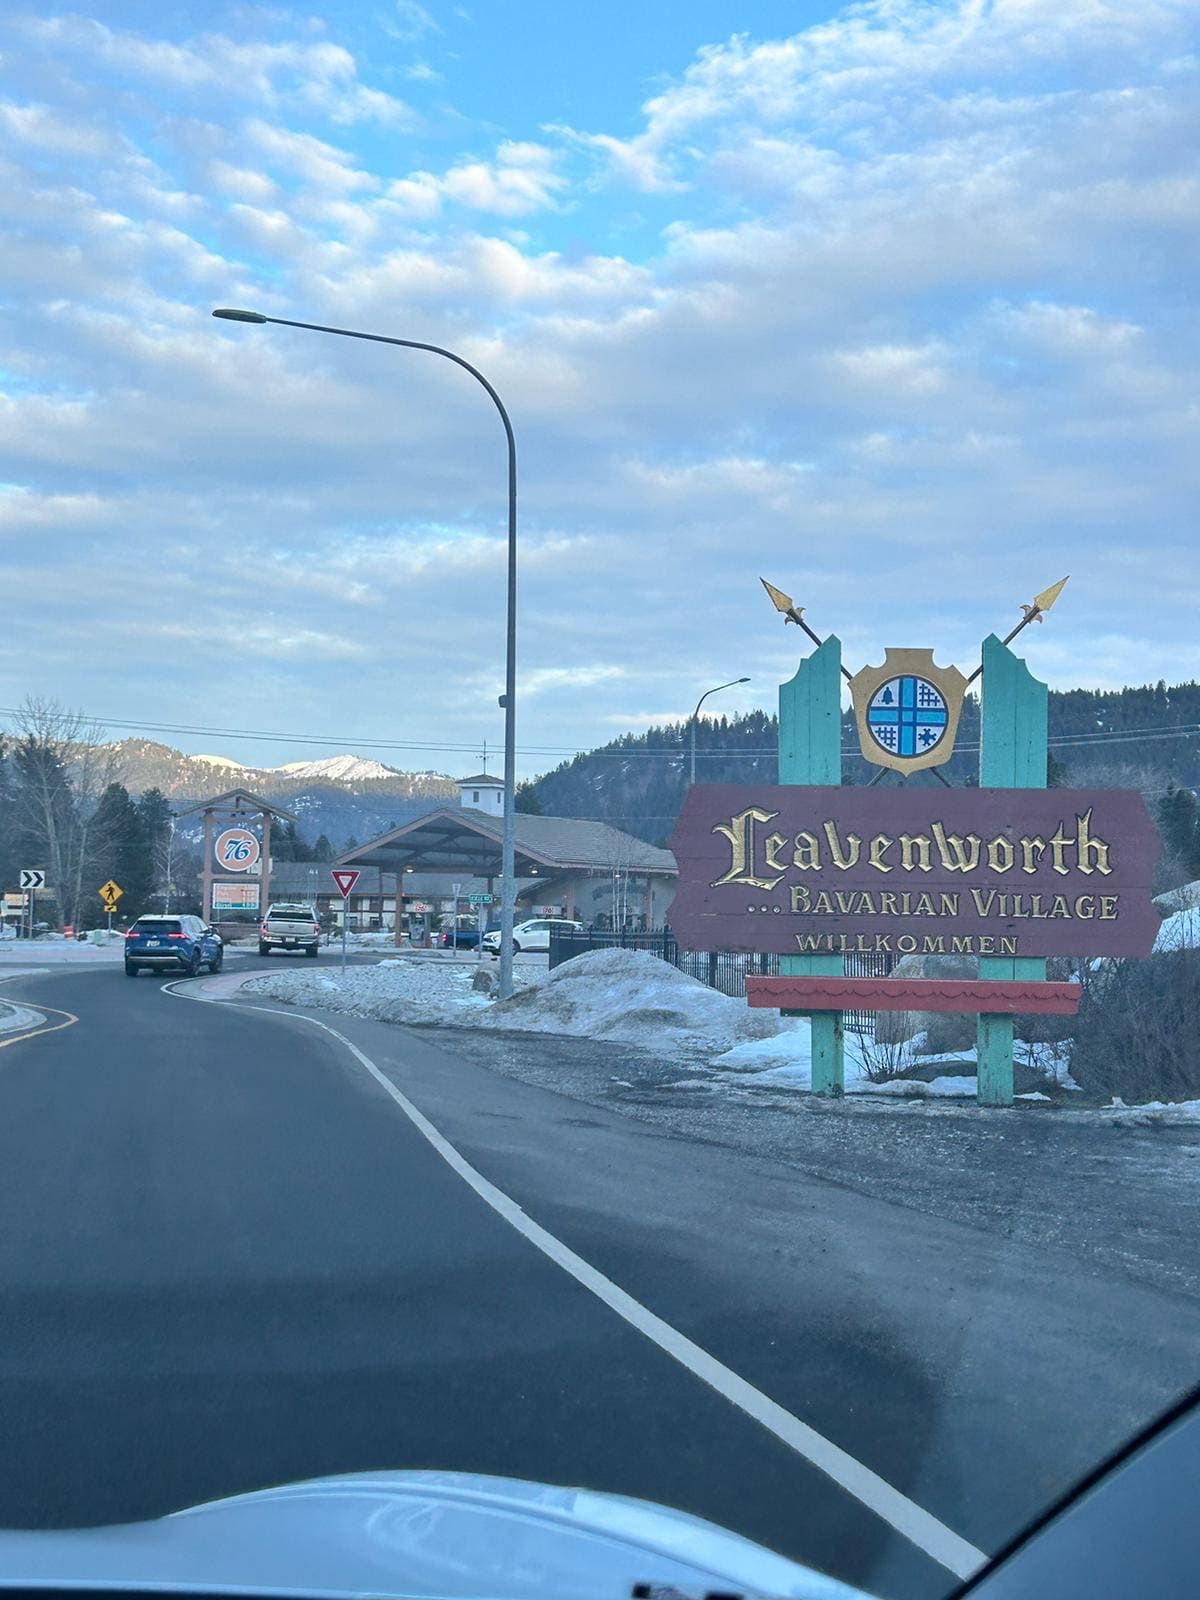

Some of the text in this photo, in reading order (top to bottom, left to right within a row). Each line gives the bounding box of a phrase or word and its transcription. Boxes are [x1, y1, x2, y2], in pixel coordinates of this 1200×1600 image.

[224, 837, 254, 862] 76
[709, 805, 1114, 891] Leavenworth
[970, 888, 1121, 920] VILLAGE
[794, 933, 1019, 955] WILLKOMMEN
